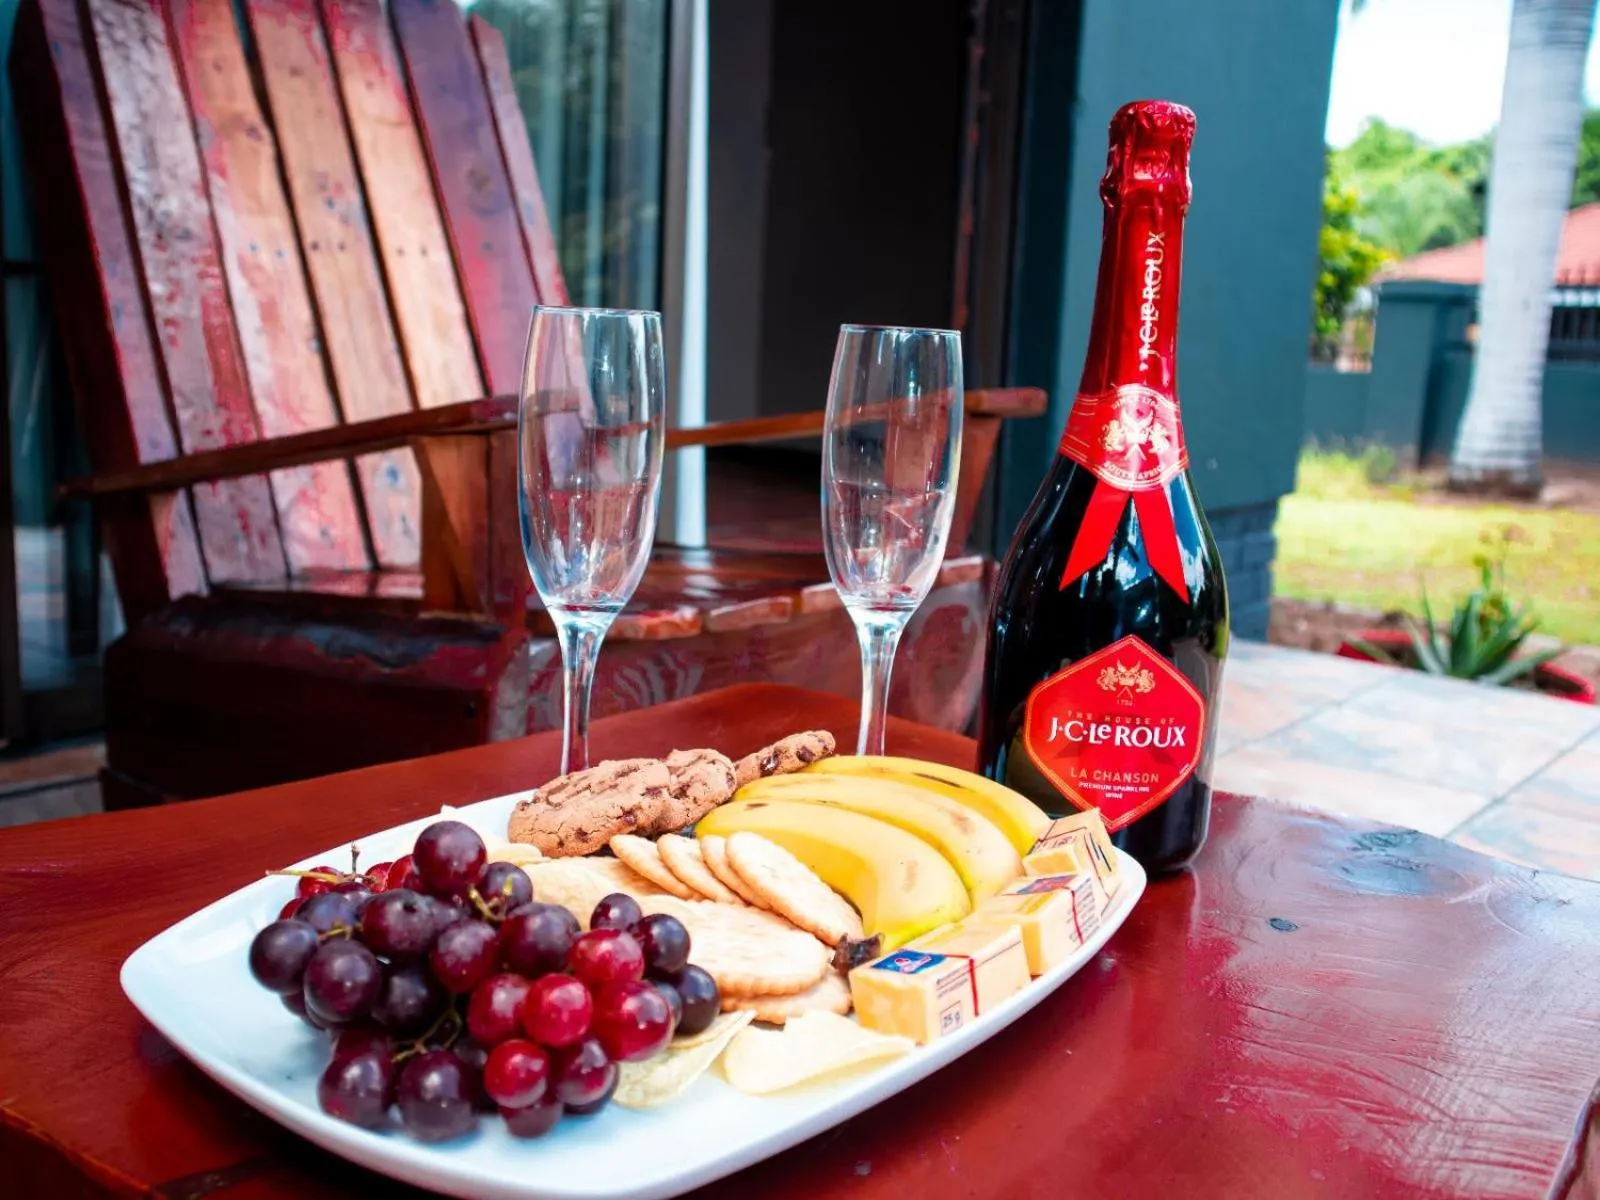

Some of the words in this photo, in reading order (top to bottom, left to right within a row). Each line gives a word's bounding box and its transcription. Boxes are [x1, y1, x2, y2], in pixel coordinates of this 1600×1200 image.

[1142, 231, 1165, 300] ROUX
[1104, 715, 1152, 725] HOUSE
[1160, 717, 1176, 725] OF
[1114, 725, 1186, 748] ROUX
[1071, 767, 1087, 779] LA
[1093, 770, 1159, 784] CHANSON
[1079, 782, 1112, 791] PREMIUM
